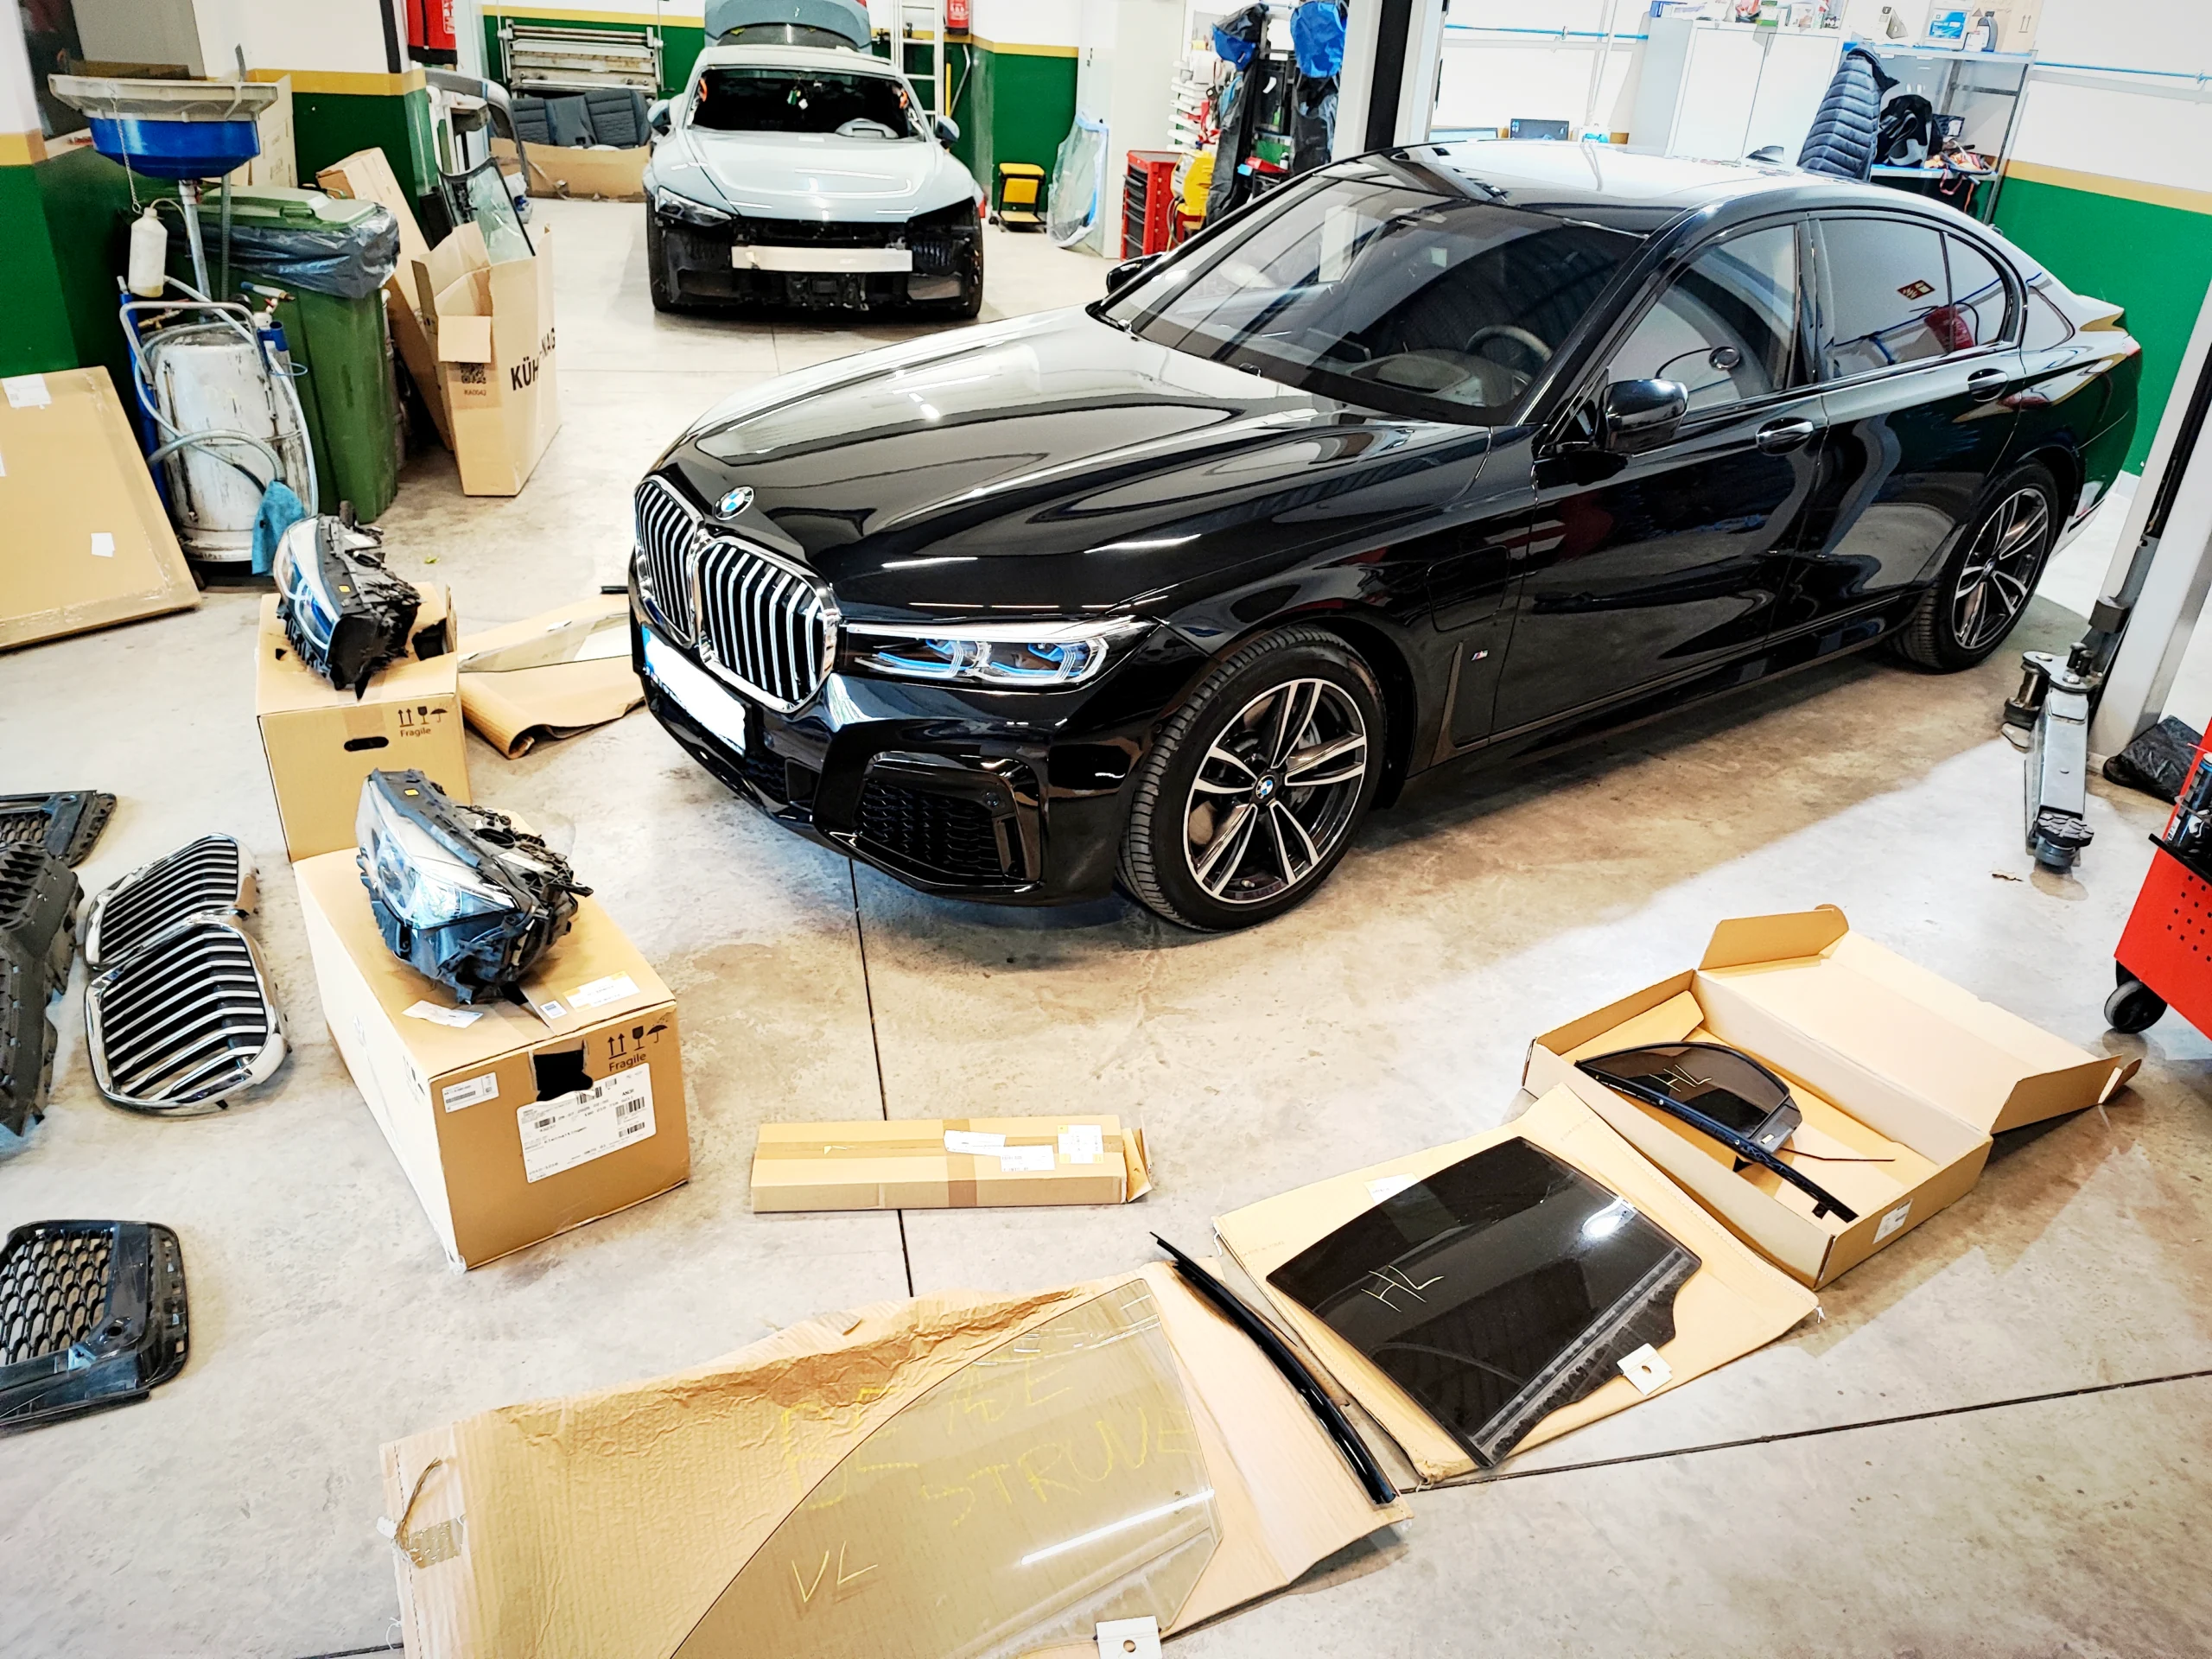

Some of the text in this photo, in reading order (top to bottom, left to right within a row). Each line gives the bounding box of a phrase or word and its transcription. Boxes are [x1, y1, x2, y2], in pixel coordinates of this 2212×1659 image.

[400, 728, 431, 737] Fragile
[608, 1053, 646, 1071] Fragile
[1648, 1064, 1713, 1093] HL
[1360, 1264, 1445, 1313] HL
[791, 1541, 879, 1603] VL
